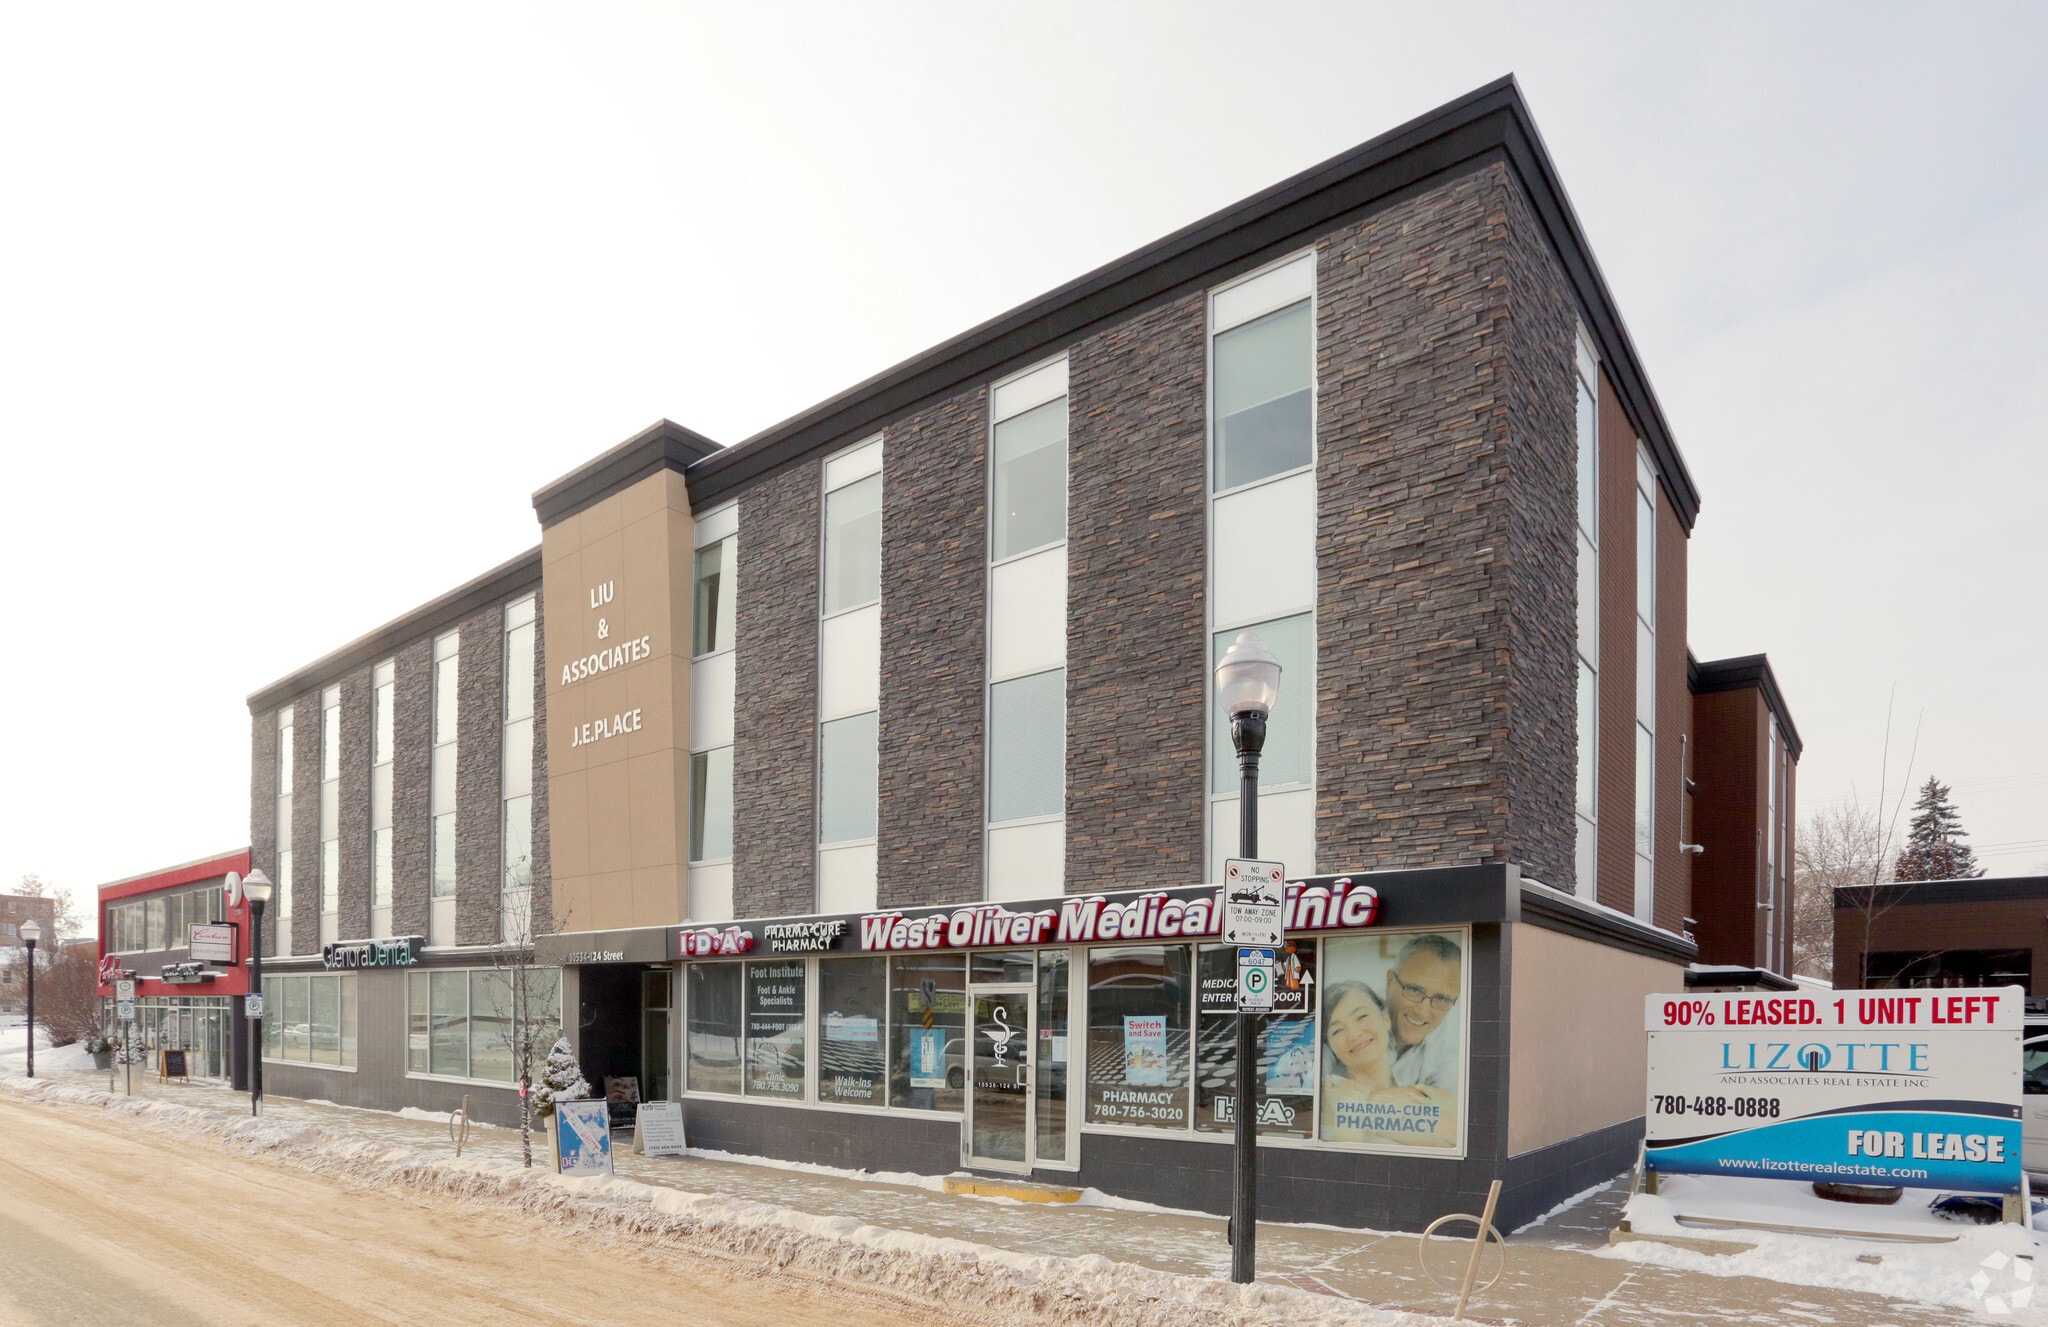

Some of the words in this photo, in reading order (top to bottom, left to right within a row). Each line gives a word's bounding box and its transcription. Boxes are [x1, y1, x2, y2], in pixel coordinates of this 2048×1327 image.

[590, 580, 614, 609] LIU
[598, 618, 609, 639] &
[561, 635, 651, 686] ASSOCIATES
[1241, 875, 1270, 884] STOPPING
[861, 913, 946, 951] West
[949, 907, 1054, 947] Oliver
[1056, 888, 1224, 942] Medical
[1284, 879, 1374, 930] inic
[1244, 908, 1258, 916] AWAY
[1262, 909, 1277, 917] ZONE
[764, 922, 842, 940] PHARMA-CURE
[772, 935, 832, 952] PHARMACY
[603, 950, 624, 961] Street
[750, 967, 767, 978] Foot
[769, 966, 804, 978] Institute
[1202, 979, 1238, 989] MEDICA
[1252, 974, 1262, 988] P
[757, 985, 771, 994] Foot
[771, 985, 777, 994] &
[778, 985, 796, 994] Ankle
[760, 996, 793, 1006] Specialists
[1202, 993, 1232, 1002] ENTER
[1663, 1001, 1715, 1026] 90%
[1724, 998, 1823, 1026] LEASED.
[1833, 998, 1844, 1025] 1
[1858, 997, 1921, 1025] UNIT
[1931, 996, 2000, 1025] LEFT
[1129, 1020, 1162, 1029] Switch
[1720, 1042, 1930, 1072] LIZOTTE
[765, 1072, 785, 1081] Clinic
[834, 1076, 872, 1088] Walk-Ins
[1720, 1076, 1746, 1085] AND
[1749, 1076, 1820, 1086] ASSOCIATES
[1823, 1078, 1853, 1087] REAL
[1856, 1078, 1900, 1087] ESTATE
[1903, 1079, 1930, 1088] INC
[752, 1080, 799, 1092] 780.756.3090
[834, 1087, 872, 1098] Welcome
[1103, 1091, 1174, 1105] PHARMACY
[1094, 1104, 1184, 1120] 780-756-3020
[1336, 1102, 1440, 1118] PHARMA-CURE
[1654, 1095, 1781, 1119] 780-488-0888
[1336, 1115, 1439, 1134] PHARMACY
[1847, 1130, 1905, 1158] FOR
[1912, 1132, 2005, 1163] LEASE
[1719, 1156, 1928, 1180] www.lizotterealestate.com
